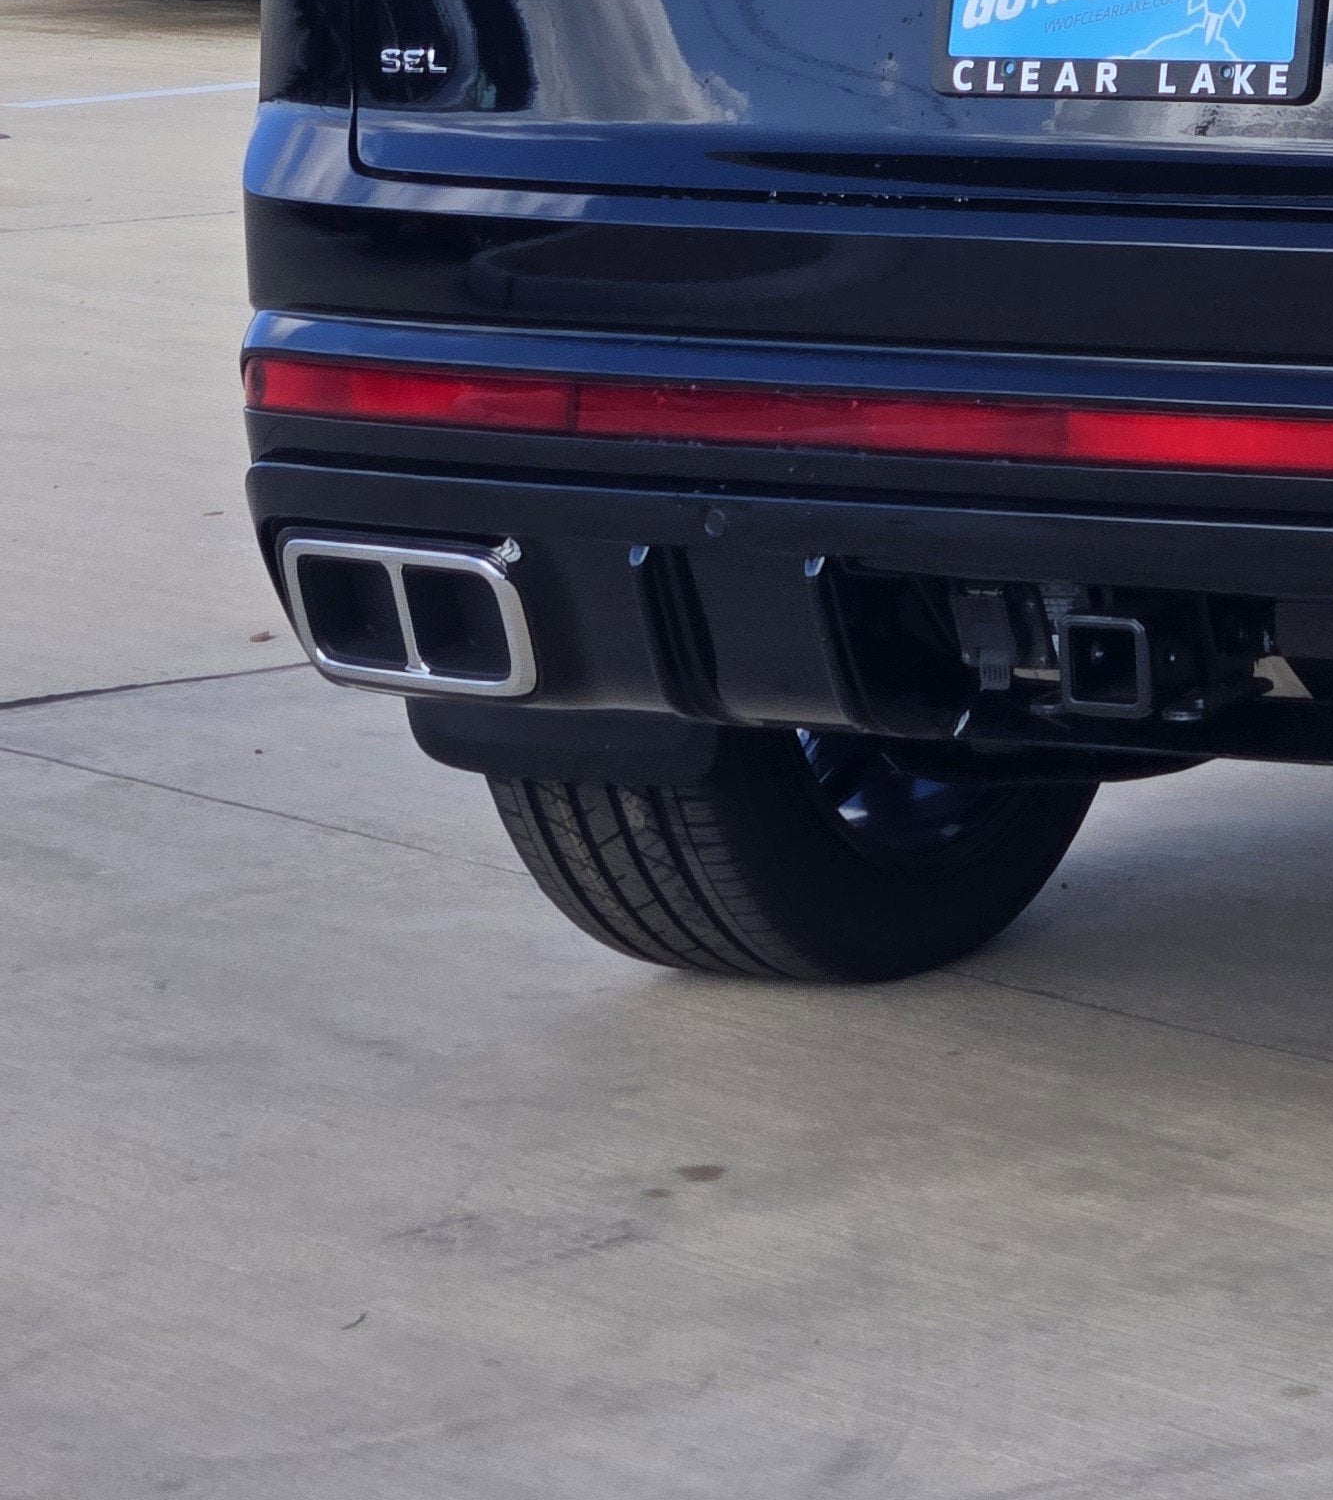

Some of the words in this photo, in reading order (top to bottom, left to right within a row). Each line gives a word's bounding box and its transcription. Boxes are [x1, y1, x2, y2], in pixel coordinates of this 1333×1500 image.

[380, 48, 448, 74] SEL
[952, 60, 1118, 94] CLEAR
[1158, 63, 1290, 96] LAKE
